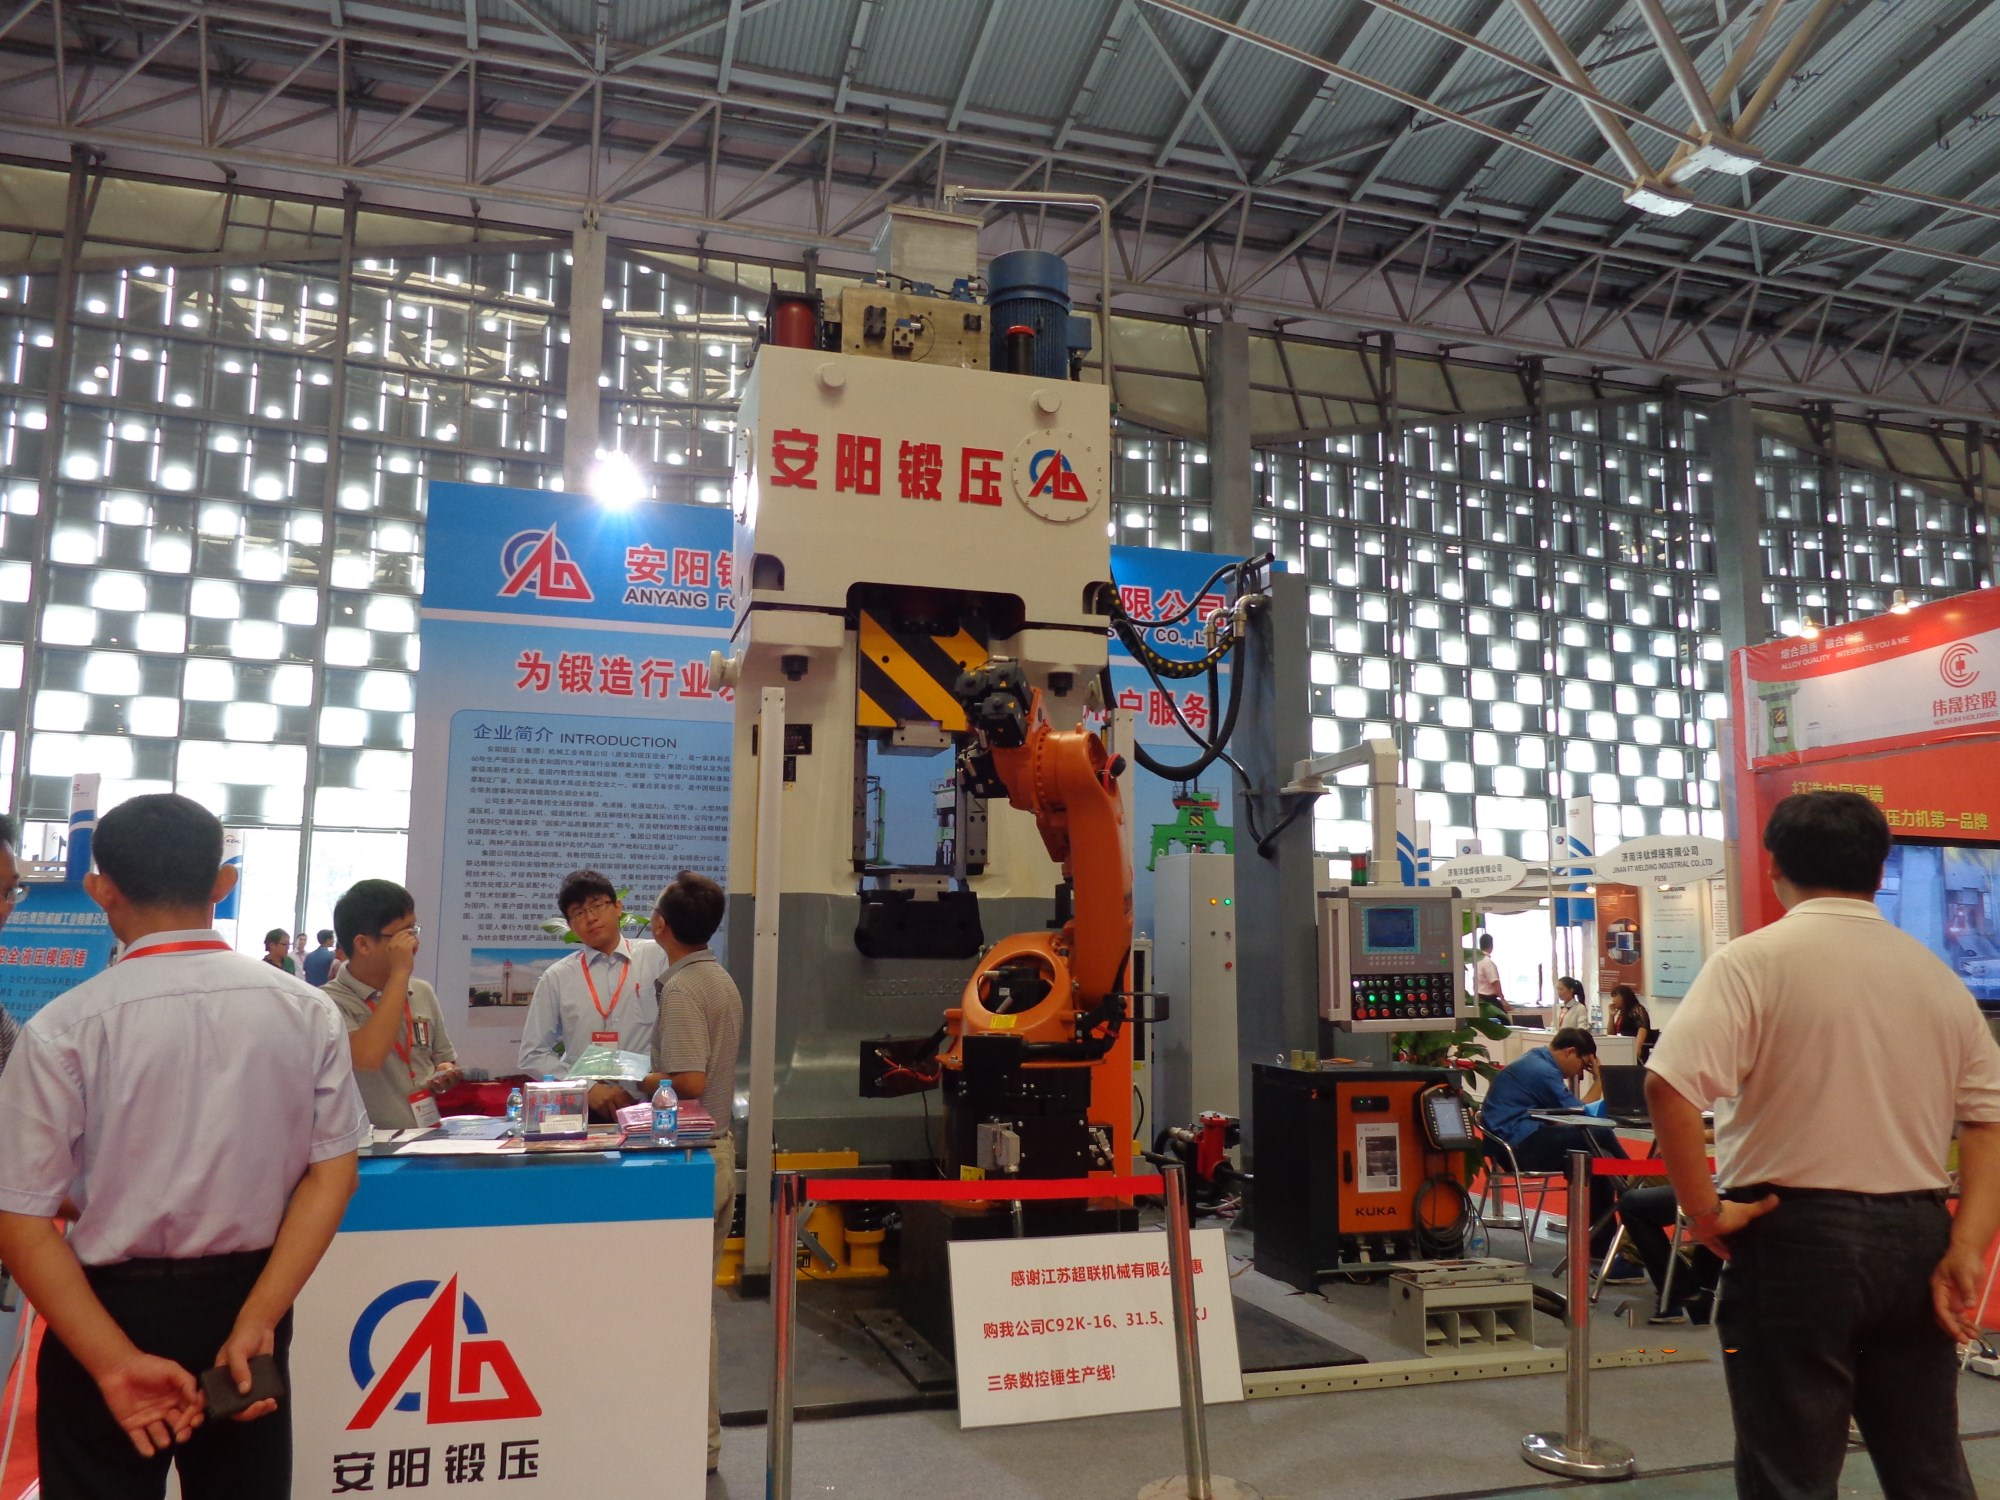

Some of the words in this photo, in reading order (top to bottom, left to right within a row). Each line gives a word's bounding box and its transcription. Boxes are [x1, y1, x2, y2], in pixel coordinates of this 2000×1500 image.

[770, 429, 1004, 507] 安阳锻压
[625, 588, 708, 609] ANYANG
[1781, 660, 1802, 670] ALLOY
[1802, 654, 1831, 666] QUALITY
[1836, 645, 1874, 658] INTEGRATE
[1875, 640, 1891, 650] YOU
[1898, 635, 1910, 644] ME
[1933, 690, 1998, 718] 伟晟控股
[473, 723, 554, 743] 企业简介
[560, 732, 677, 749] INTRODUCTION
[1355, 1206, 1398, 1217] KUKA
[332, 1438, 540, 1494] 安阳锻压
